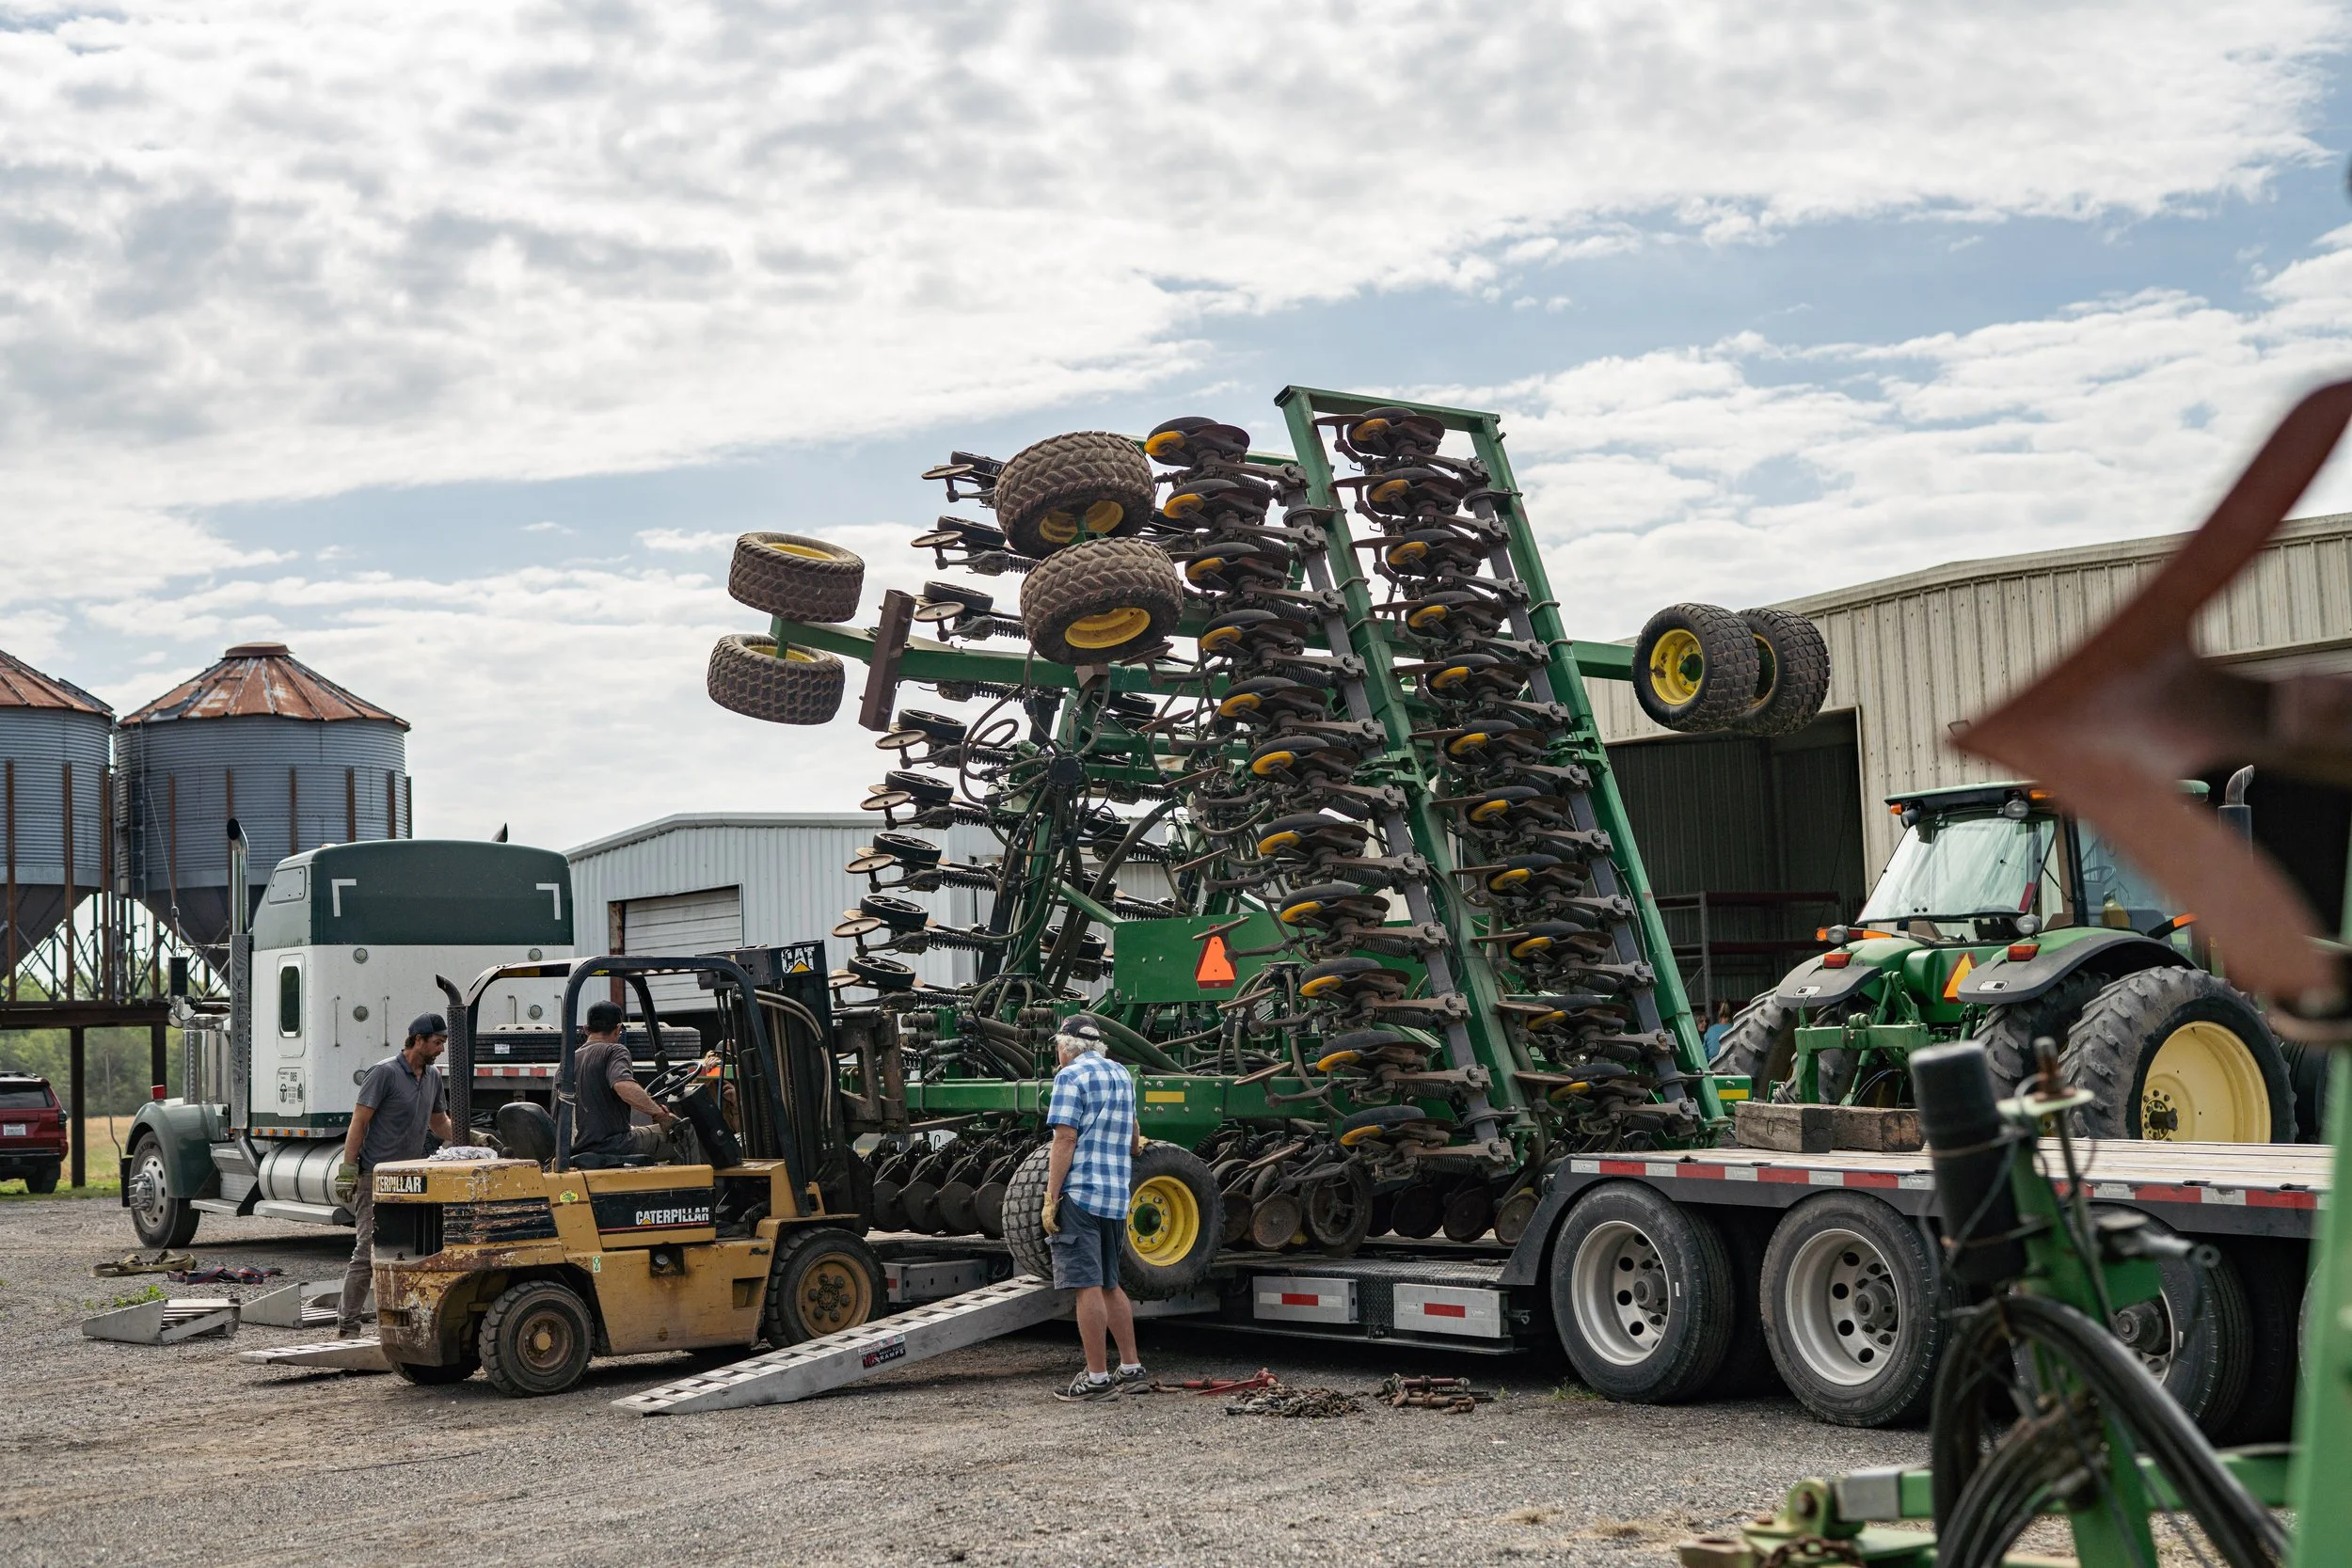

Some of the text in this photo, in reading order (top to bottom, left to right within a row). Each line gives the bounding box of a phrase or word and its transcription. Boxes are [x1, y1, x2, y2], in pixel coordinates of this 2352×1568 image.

[781, 946, 815, 974] CAT
[636, 1207, 709, 1225] CATERPILLAR
[880, 1349, 904, 1360] RAMPS
